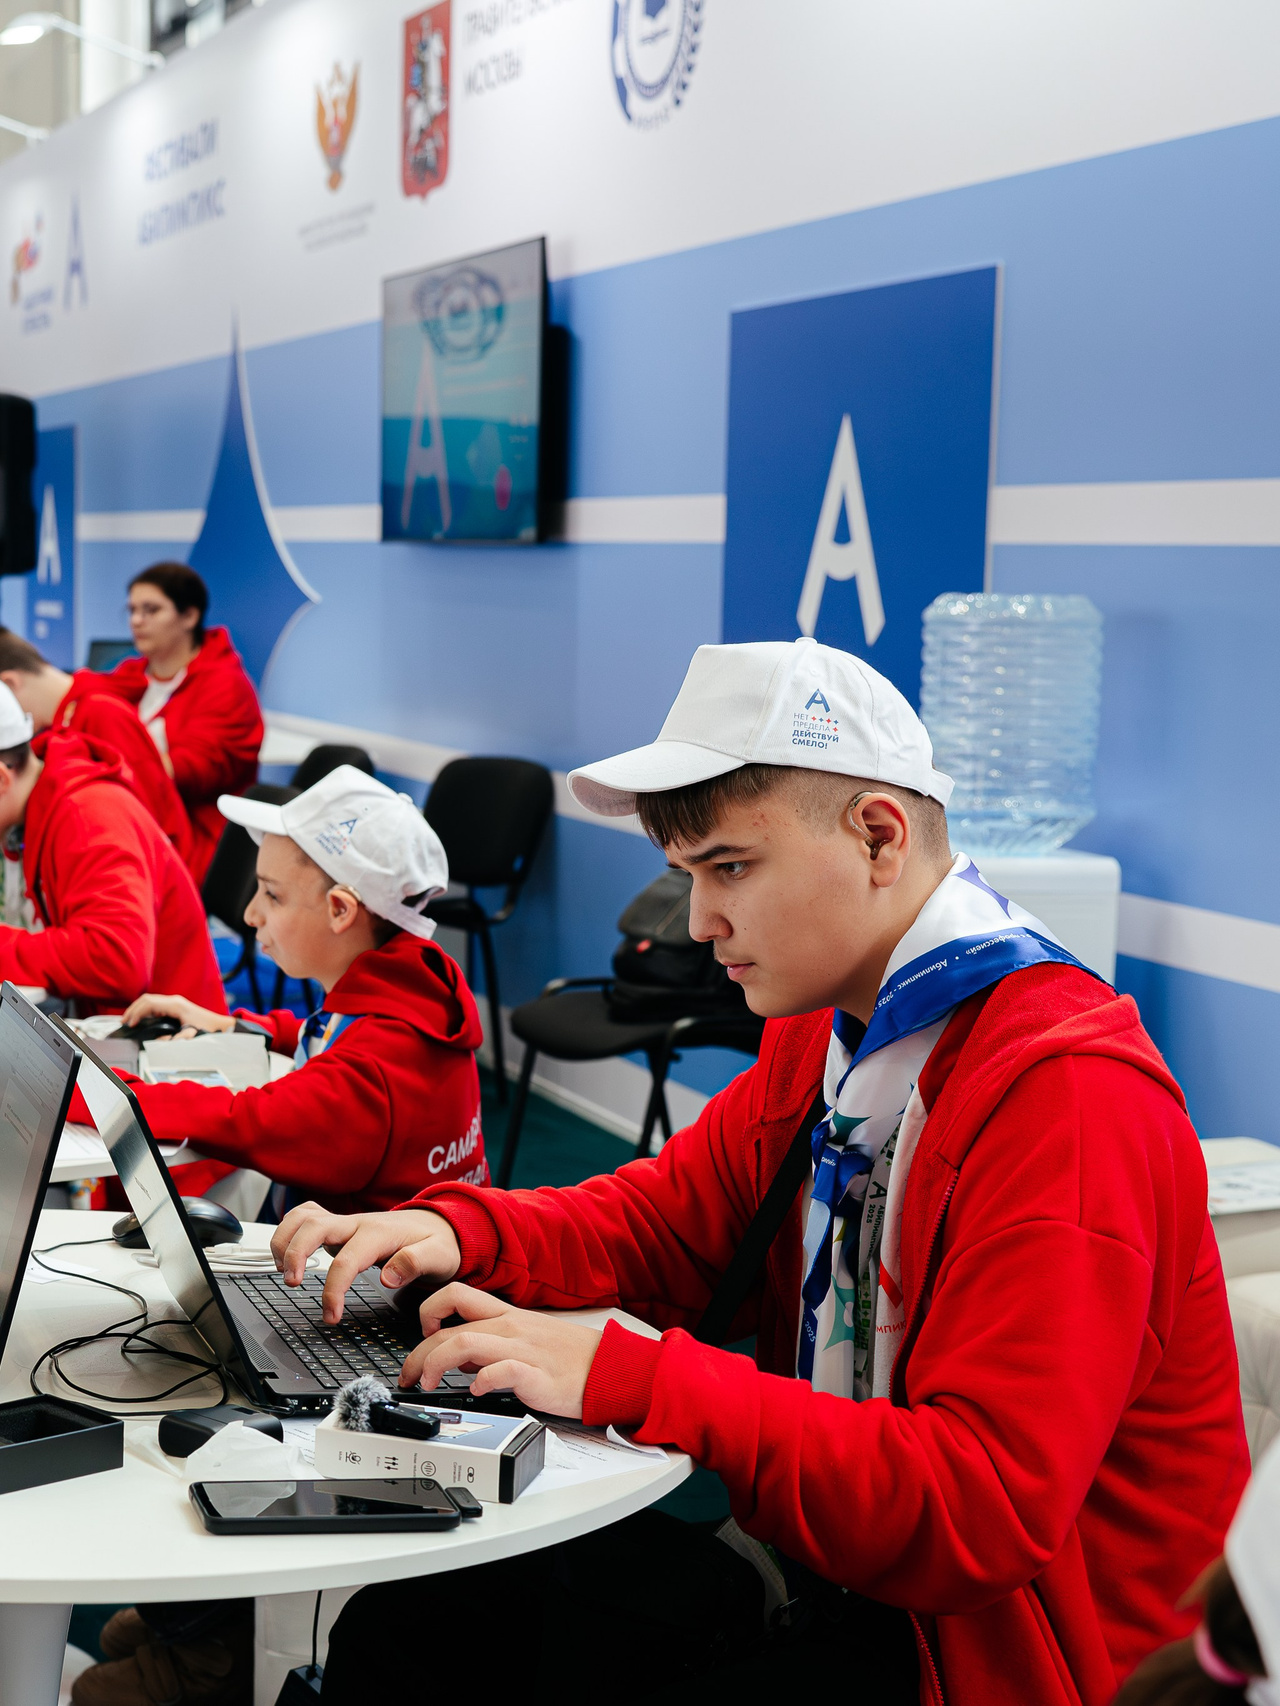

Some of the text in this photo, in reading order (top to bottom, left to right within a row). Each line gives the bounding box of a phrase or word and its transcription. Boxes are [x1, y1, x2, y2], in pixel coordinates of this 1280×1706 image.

[793, 713, 809, 721] НЕТ
[793, 721, 831, 732] ПРЕДЕЛА
[792, 730, 839, 742] ДЕЙСТВУЙ
[792, 738, 828, 749] СМЕЛО!
[897, 959, 948, 990] Абилимпикс
[866, 1204, 876, 1224] 2025
[805, 1321, 816, 1342] 2025
